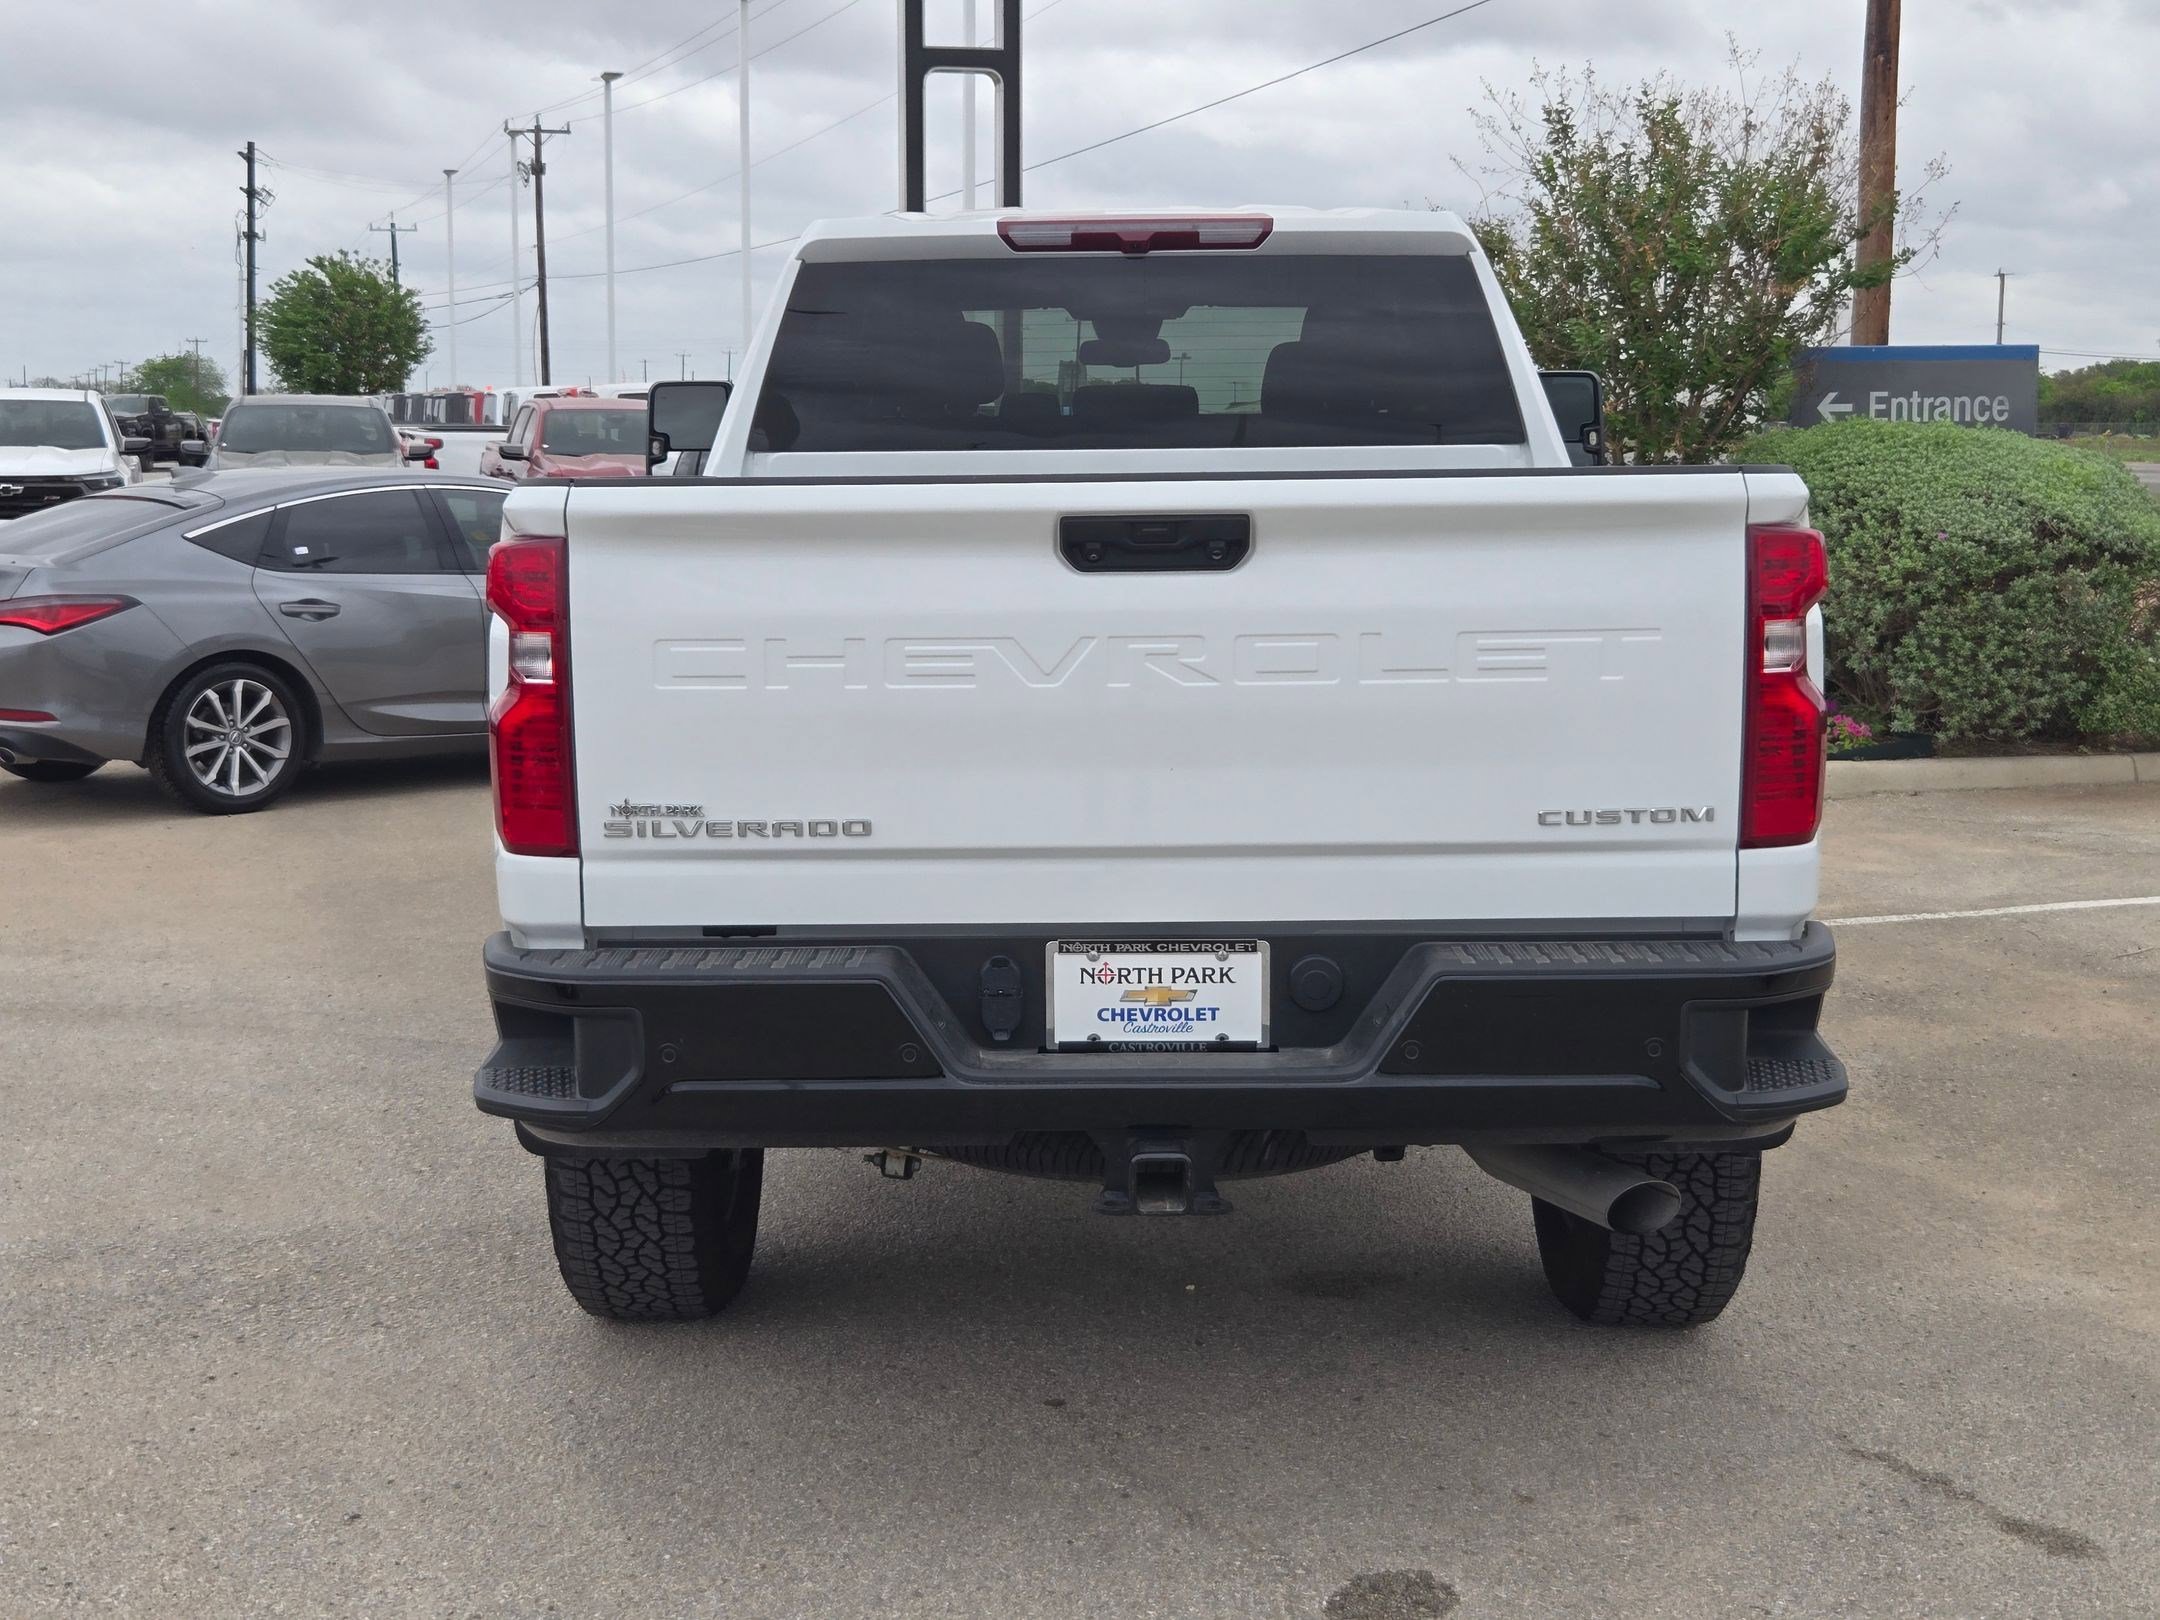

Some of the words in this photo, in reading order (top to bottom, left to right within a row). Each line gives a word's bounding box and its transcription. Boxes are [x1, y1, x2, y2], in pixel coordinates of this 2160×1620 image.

[1868, 390, 2010, 423] Entrance
[653, 629, 1663, 690] CHEVROLET
[666, 804, 705, 818] PARK
[1537, 806, 1715, 826] CUSTOM
[604, 819, 873, 839] SILVERADO
[1061, 942, 1111, 953] NORTH
[1115, 943, 1153, 953] PARK
[1156, 943, 1255, 953] CHEVROLET
[1080, 964, 1162, 984] NORTH
[1171, 967, 1236, 984] PARK
[1097, 1007, 1220, 1022] CHEVROLET
[1123, 1021, 1194, 1034] Castroville
[1108, 1042, 1208, 1053] CASTROVILLE
